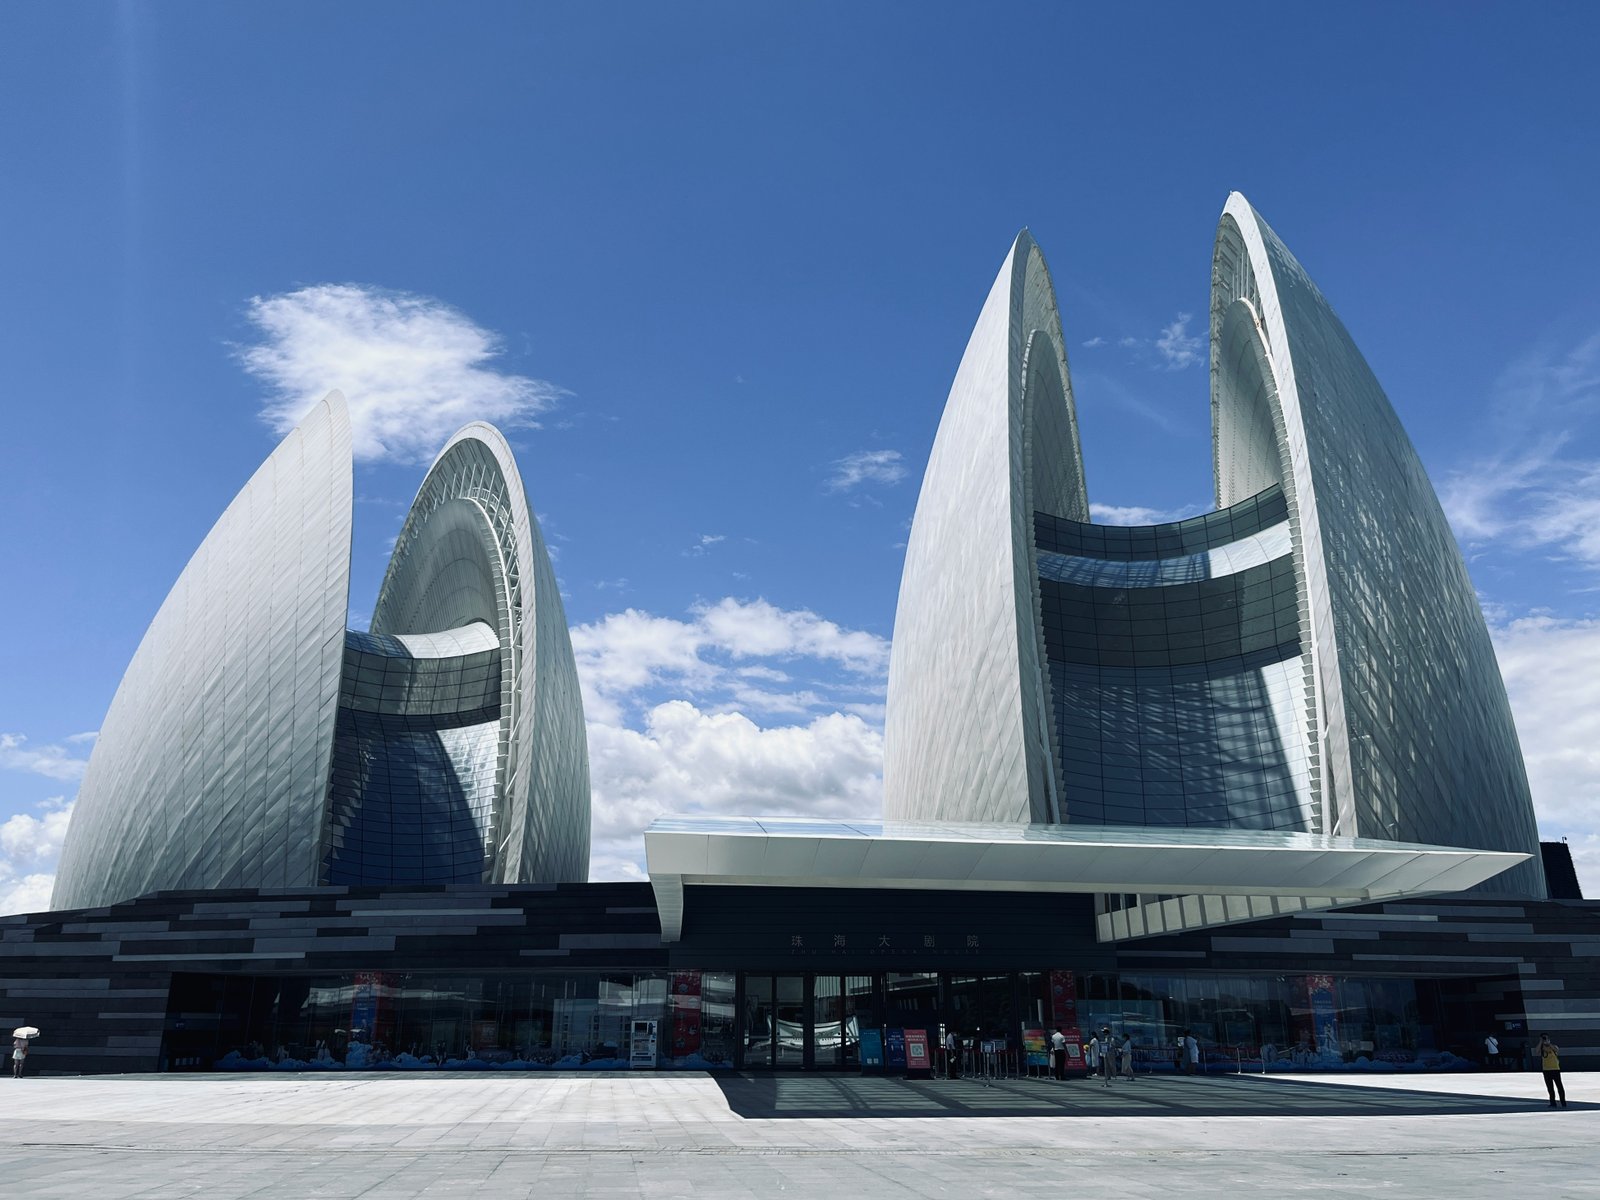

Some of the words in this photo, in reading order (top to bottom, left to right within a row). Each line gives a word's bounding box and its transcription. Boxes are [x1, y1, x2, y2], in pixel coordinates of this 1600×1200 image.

[791, 934, 980, 948] 珠海大剧院
